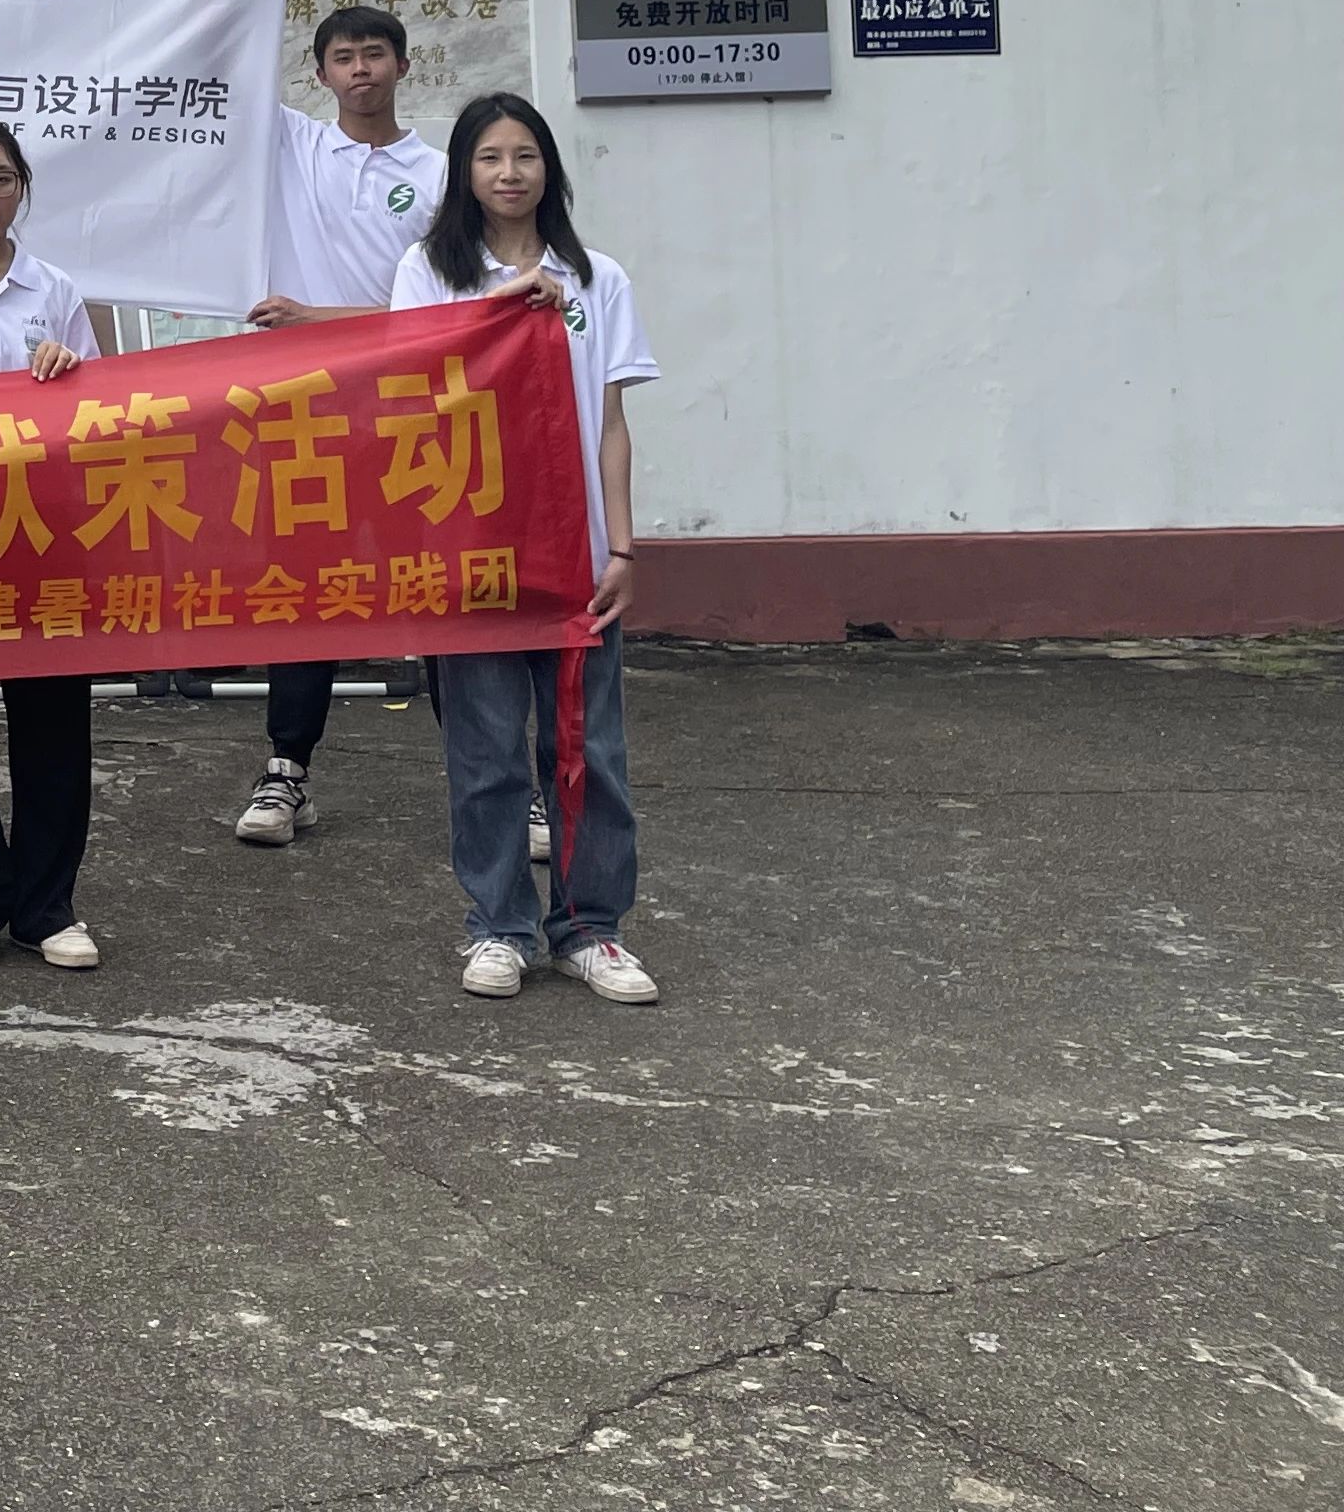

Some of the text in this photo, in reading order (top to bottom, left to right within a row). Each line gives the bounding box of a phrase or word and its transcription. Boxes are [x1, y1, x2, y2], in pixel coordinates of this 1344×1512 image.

[42, 124, 92, 140] ART
[104, 127, 117, 141] &
[131, 126, 226, 145] DESIGN
